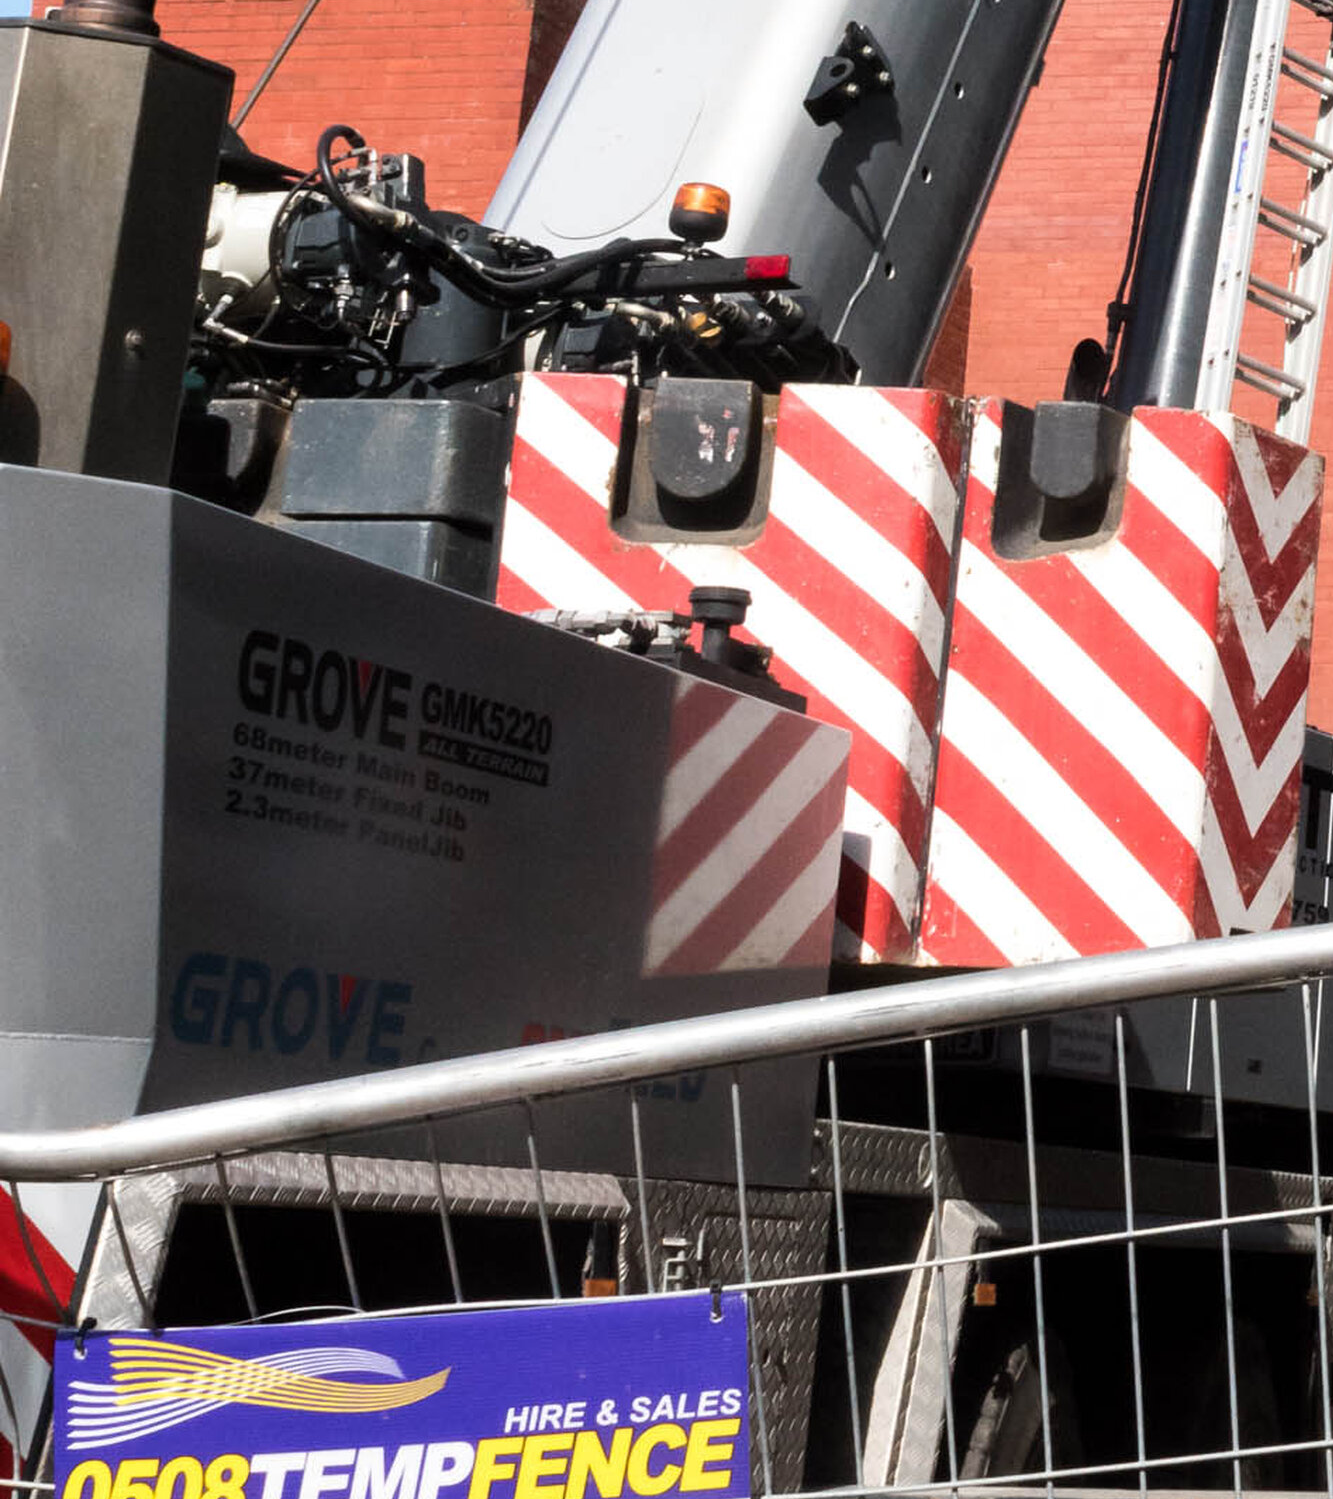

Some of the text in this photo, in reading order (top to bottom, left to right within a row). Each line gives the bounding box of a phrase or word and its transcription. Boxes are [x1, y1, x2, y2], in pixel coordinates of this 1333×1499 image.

[238, 630, 553, 755] GROVE GMK5220
[425, 770, 490, 805] Boom
[465, 746, 546, 785] TERRAIN
[171, 951, 414, 1064] GROVE
[505, 1388, 742, 1434] HIRE & SALES
